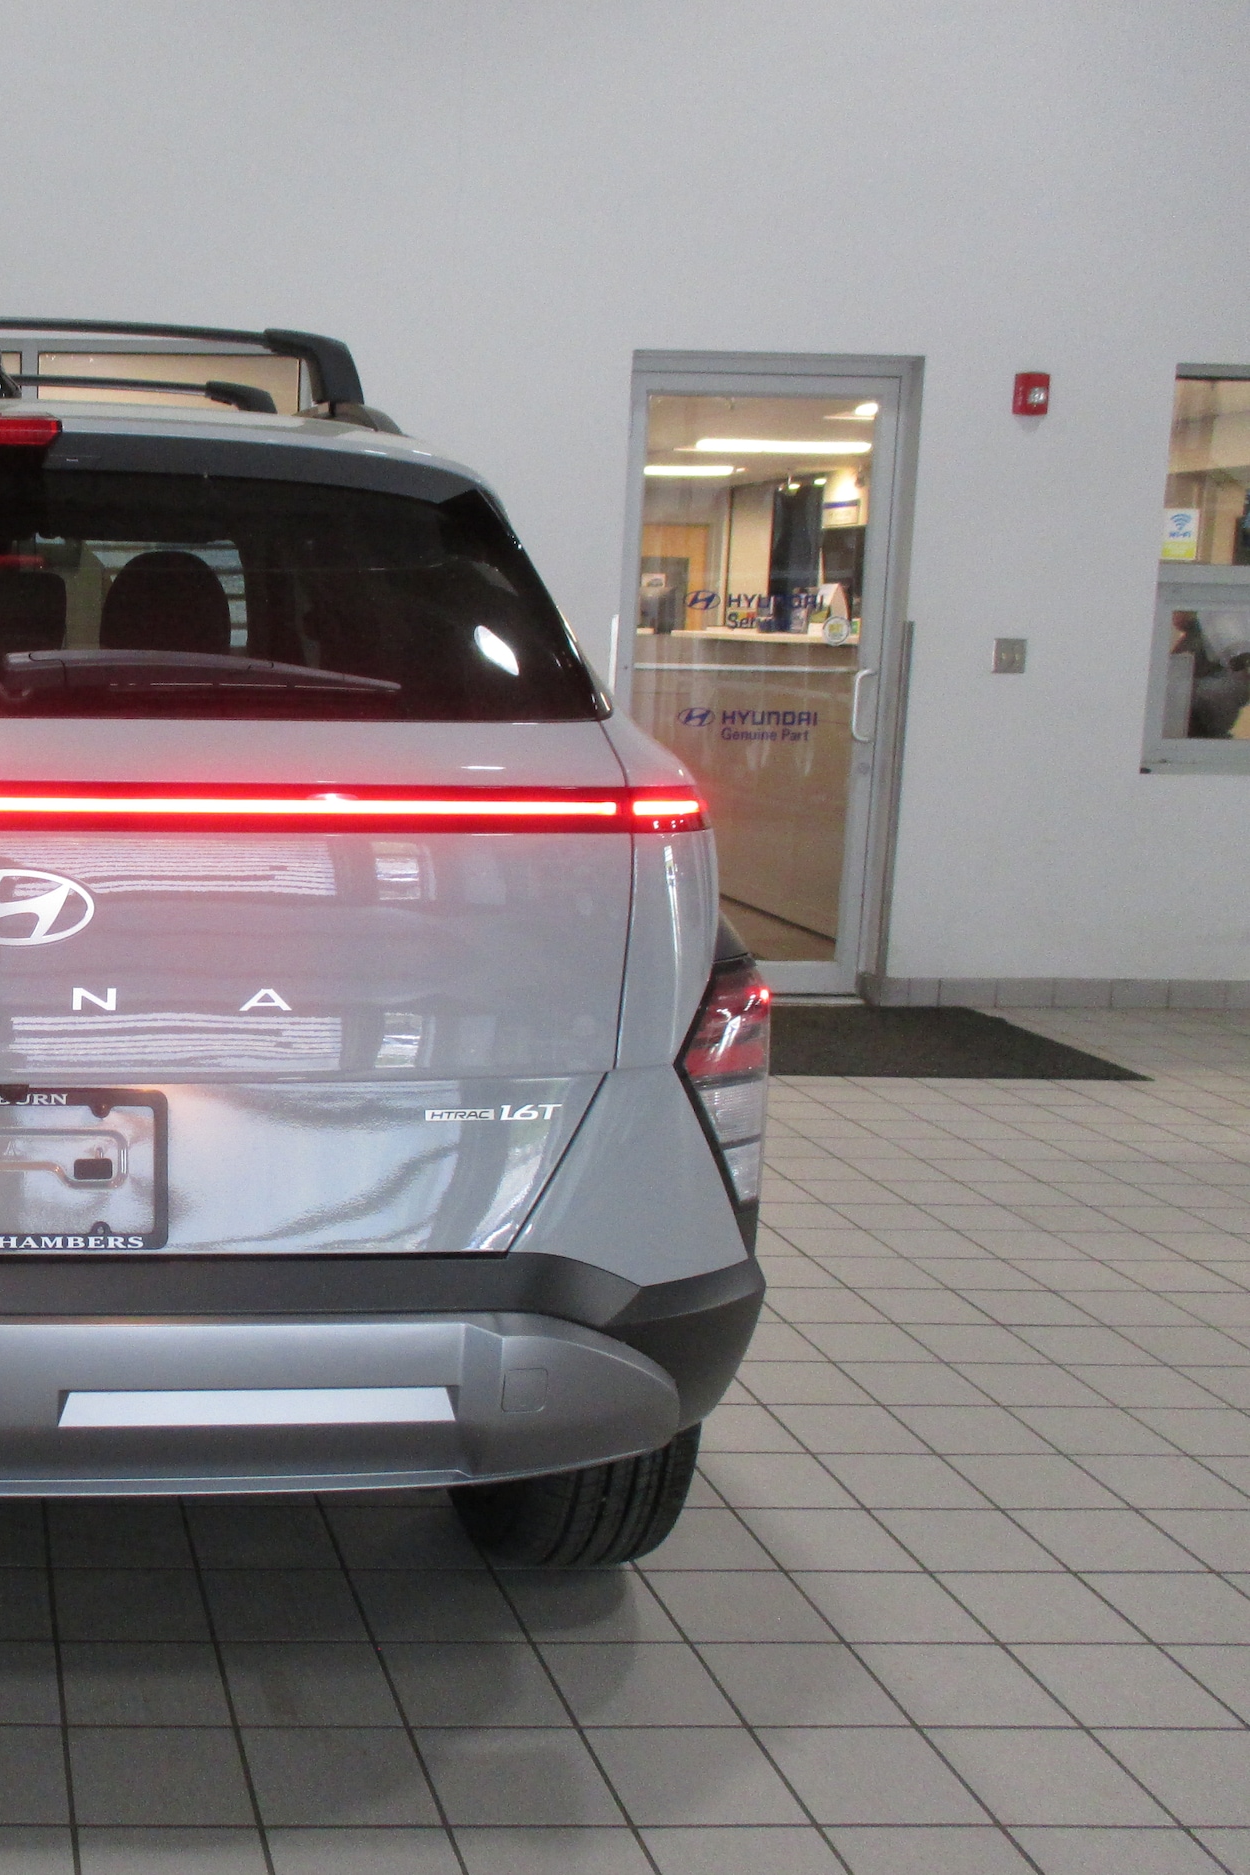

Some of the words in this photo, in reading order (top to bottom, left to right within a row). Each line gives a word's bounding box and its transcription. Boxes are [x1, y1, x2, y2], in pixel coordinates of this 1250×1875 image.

[727, 611, 780, 629] Serv
[721, 710, 818, 726] HYUNDAI
[721, 727, 777, 741] Genuine
[781, 728, 809, 742] Part
[429, 1110, 492, 1120] HTRAC
